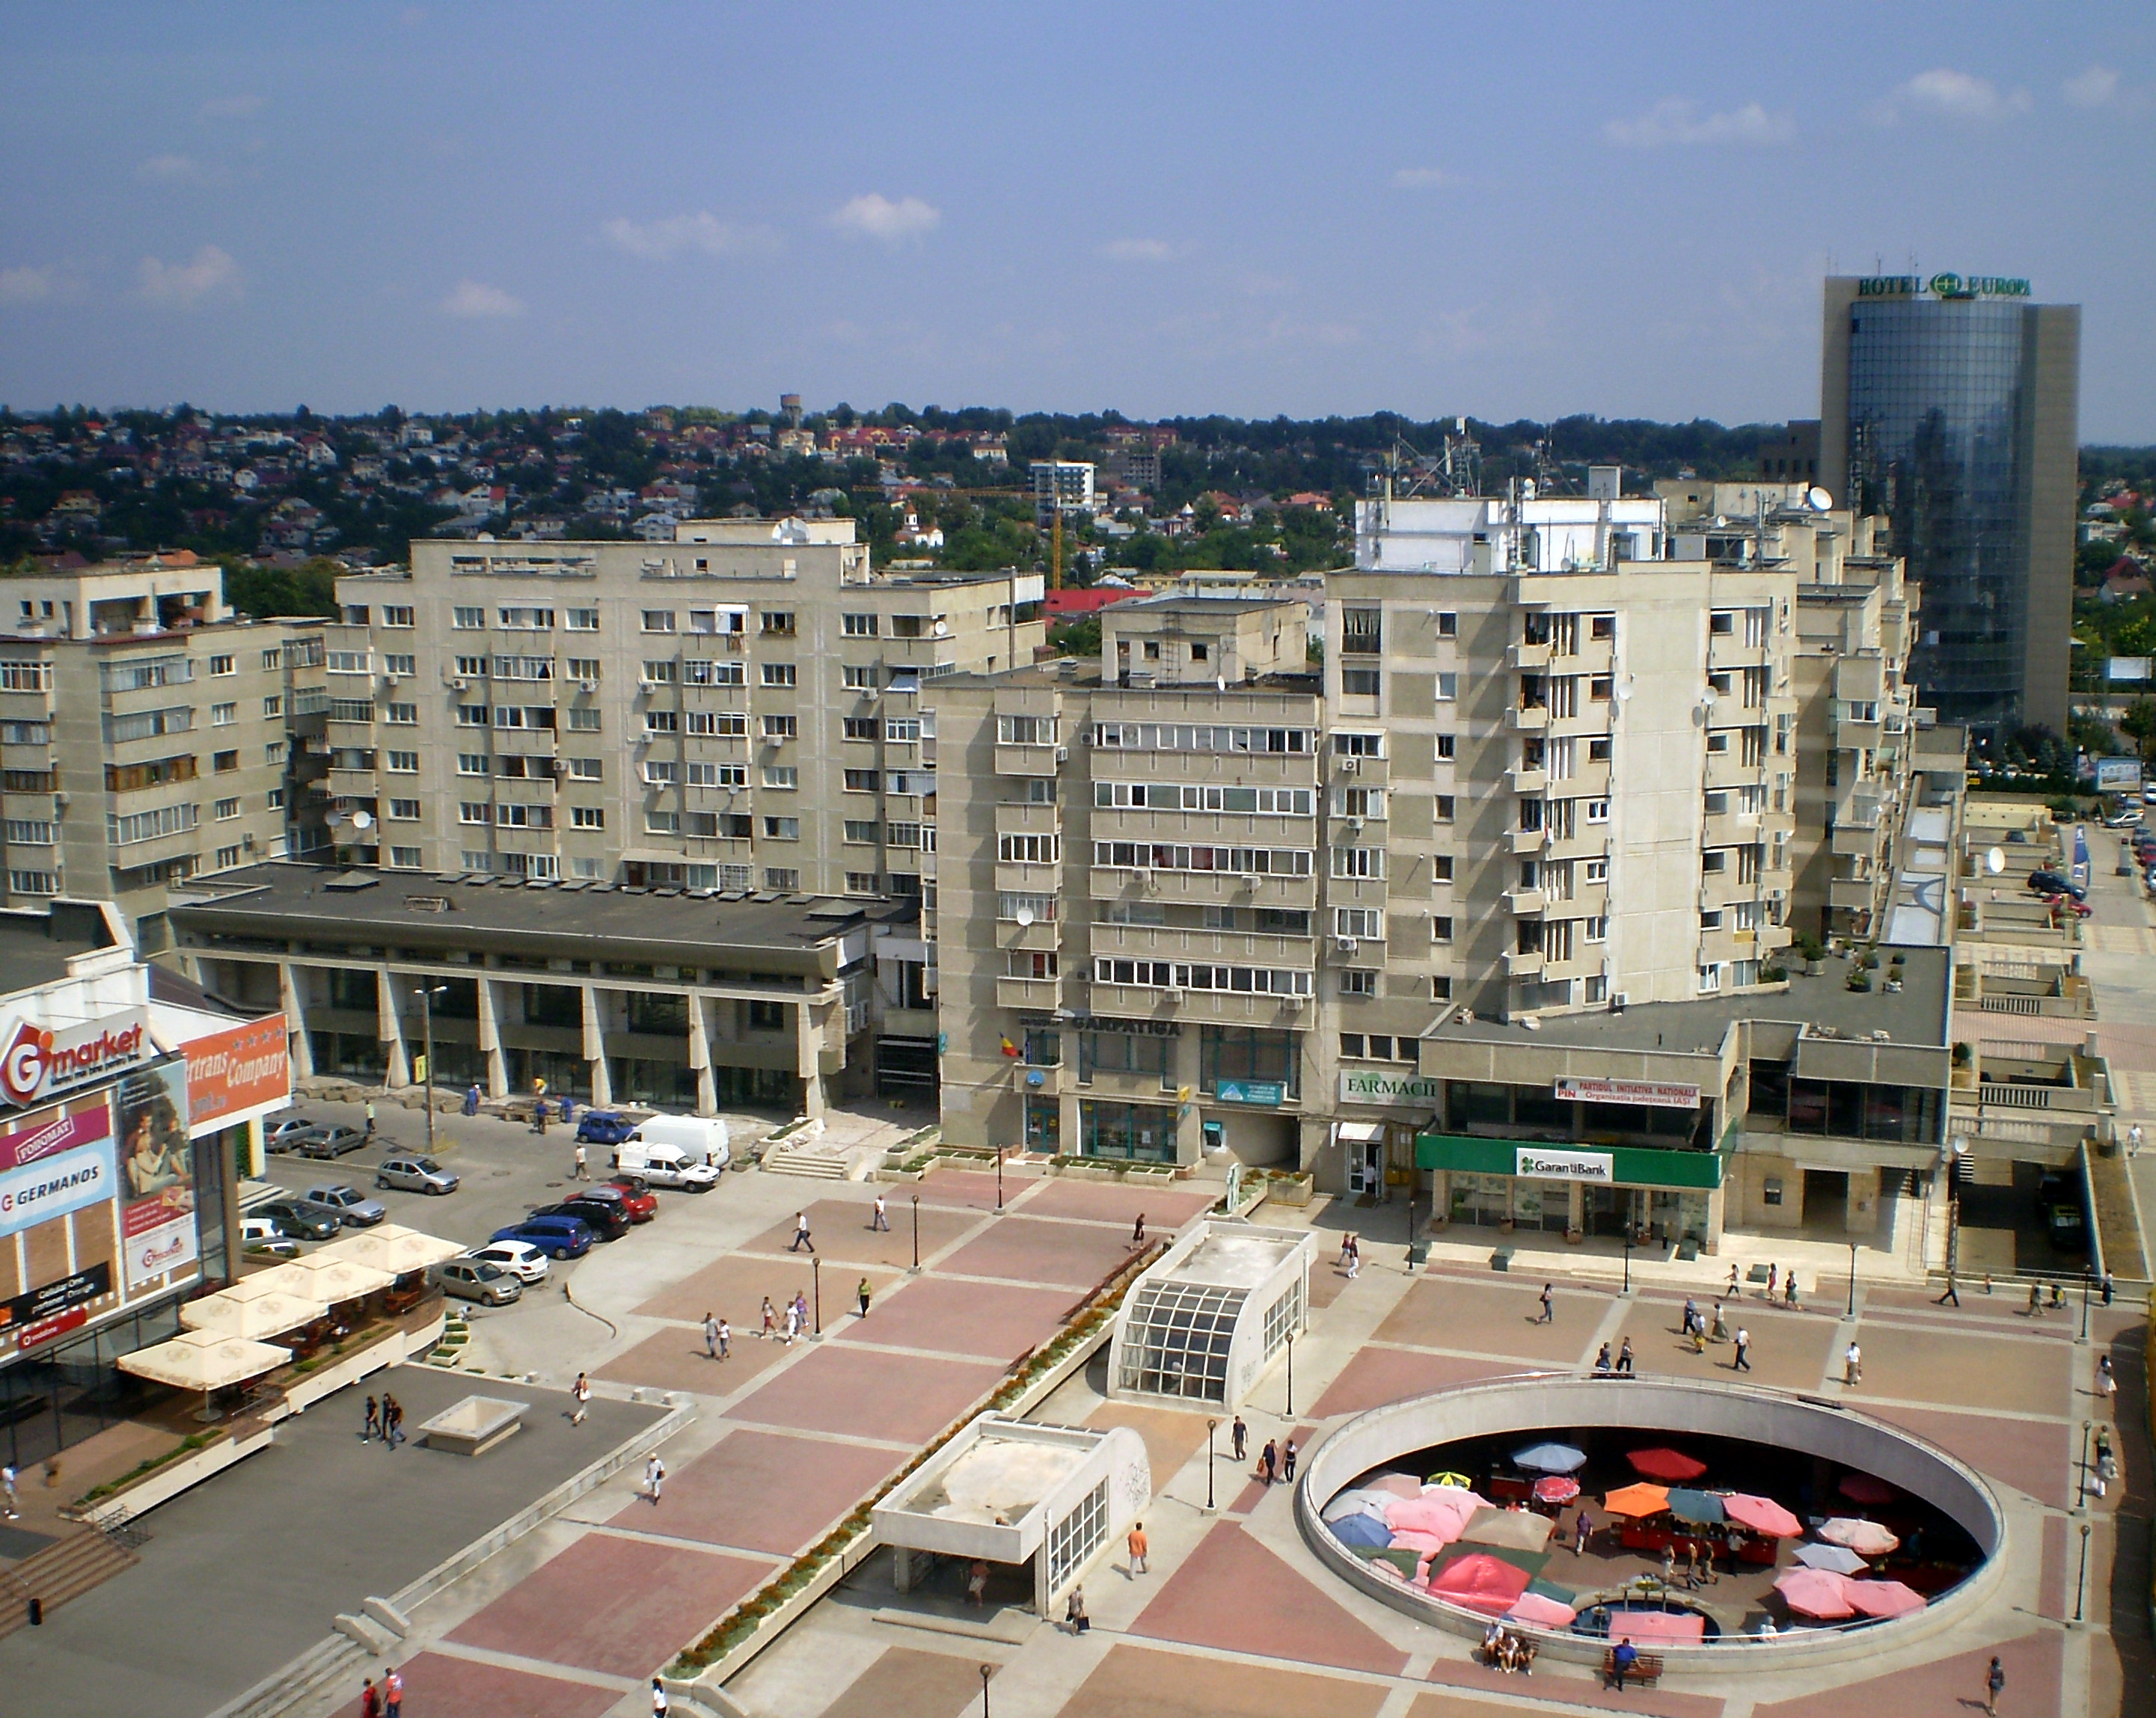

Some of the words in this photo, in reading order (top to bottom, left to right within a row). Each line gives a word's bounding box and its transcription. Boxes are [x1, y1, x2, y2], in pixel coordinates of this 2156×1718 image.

[1858, 276, 1928, 295] HOTEL
[1968, 277, 2032, 296] EUROPA
[1072, 1017, 1184, 1038] CARPATICA
[227, 1050, 286, 1088] Company
[1558, 1089, 1576, 1098] PIN
[1580, 1082, 1612, 1092] PARTIDUL
[1535, 1160, 1606, 1176] GarantiBank
[17, 1166, 99, 1205] GERMANOS
